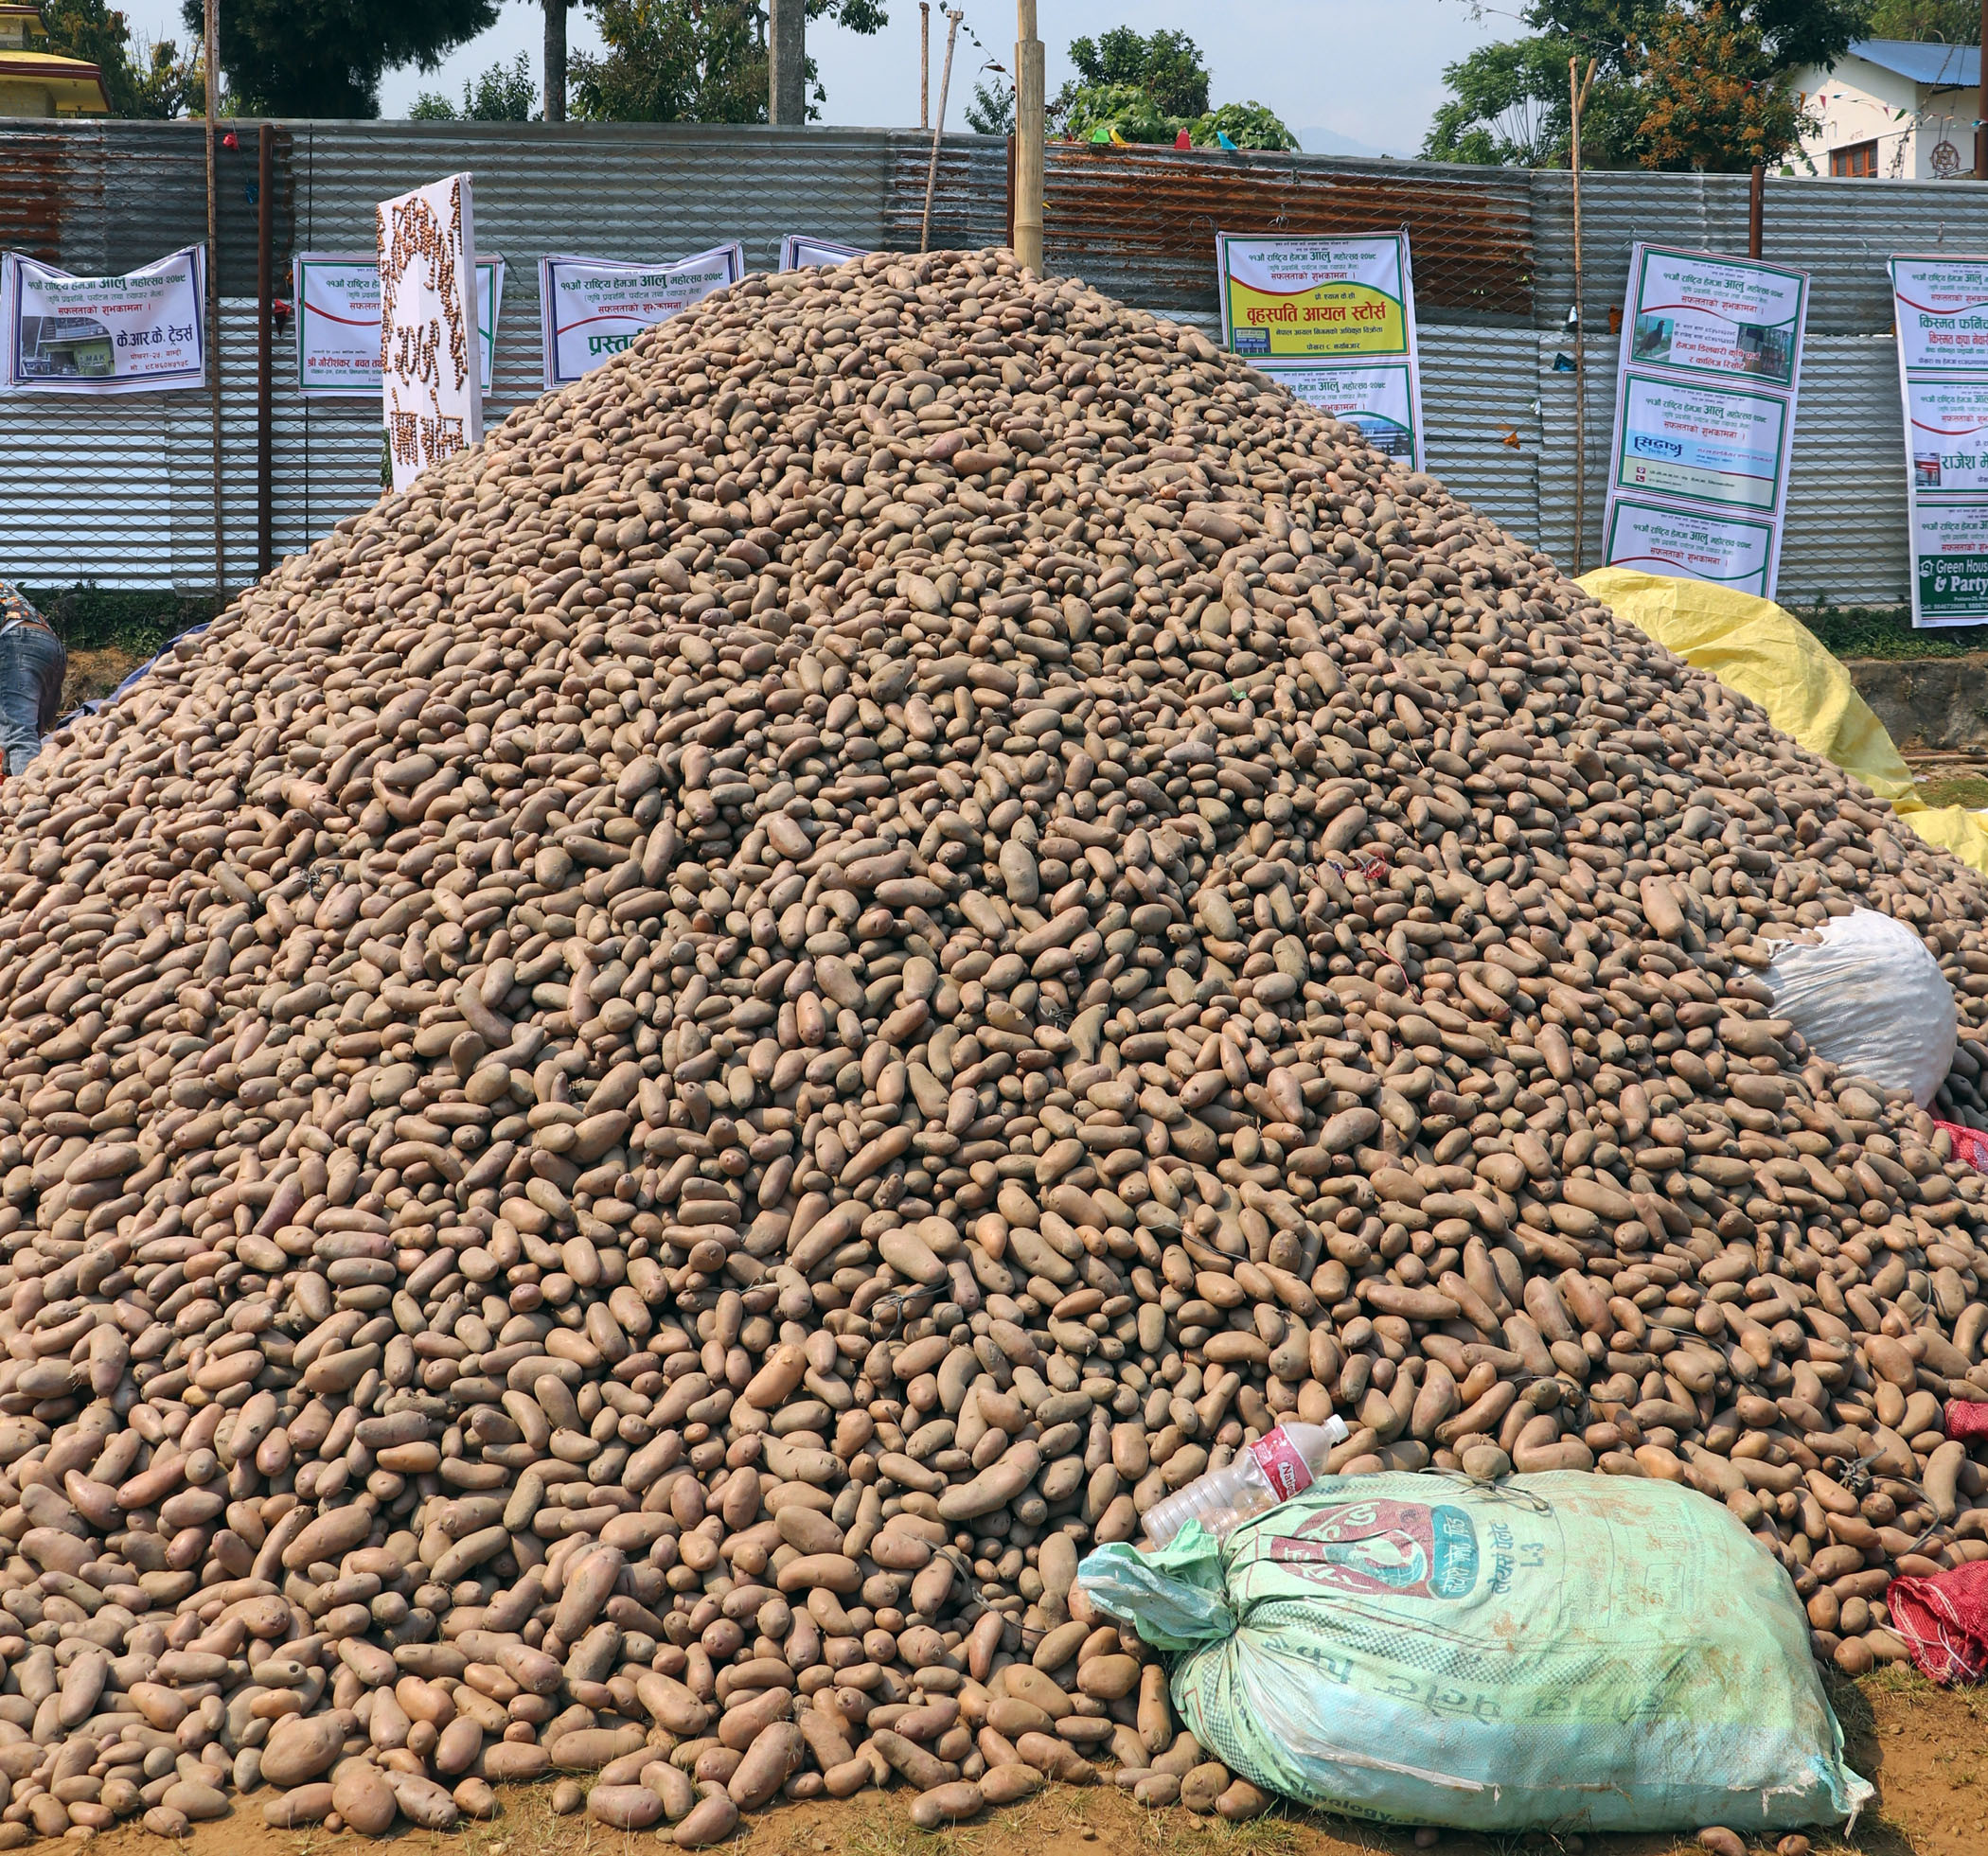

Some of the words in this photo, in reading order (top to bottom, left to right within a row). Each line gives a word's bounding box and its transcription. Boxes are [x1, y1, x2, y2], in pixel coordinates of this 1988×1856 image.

[1310, 251, 1331, 263] आलु
[98, 276, 128, 291] आलु
[613, 277, 637, 289] हेमजा
[640, 274, 667, 289] आलु
[1270, 272, 1308, 280] सफलताको
[1312, 272, 1348, 282] शुभकामना
[1965, 274, 1982, 285] आलु
[1723, 279, 1745, 292] आलु
[58, 304, 98, 316] सफलताको
[102, 303, 142, 316] शुभकामना
[597, 303, 639, 314] सफलताको
[1247, 302, 1298, 326] वृहस्पति
[1303, 306, 1346, 322] आयल
[1351, 300, 1387, 321] स्टोर्स
[1920, 313, 1955, 328] किस्मत
[1318, 380, 1340, 393] आलु
[1703, 405, 1725, 419] आलु
[1942, 451, 1976, 468] राजेश
[1689, 531, 1709, 546] आलु
[1937, 559, 1963, 573] Green
[1935, 575, 1947, 592] &
[1951, 575, 1988, 594] Party
